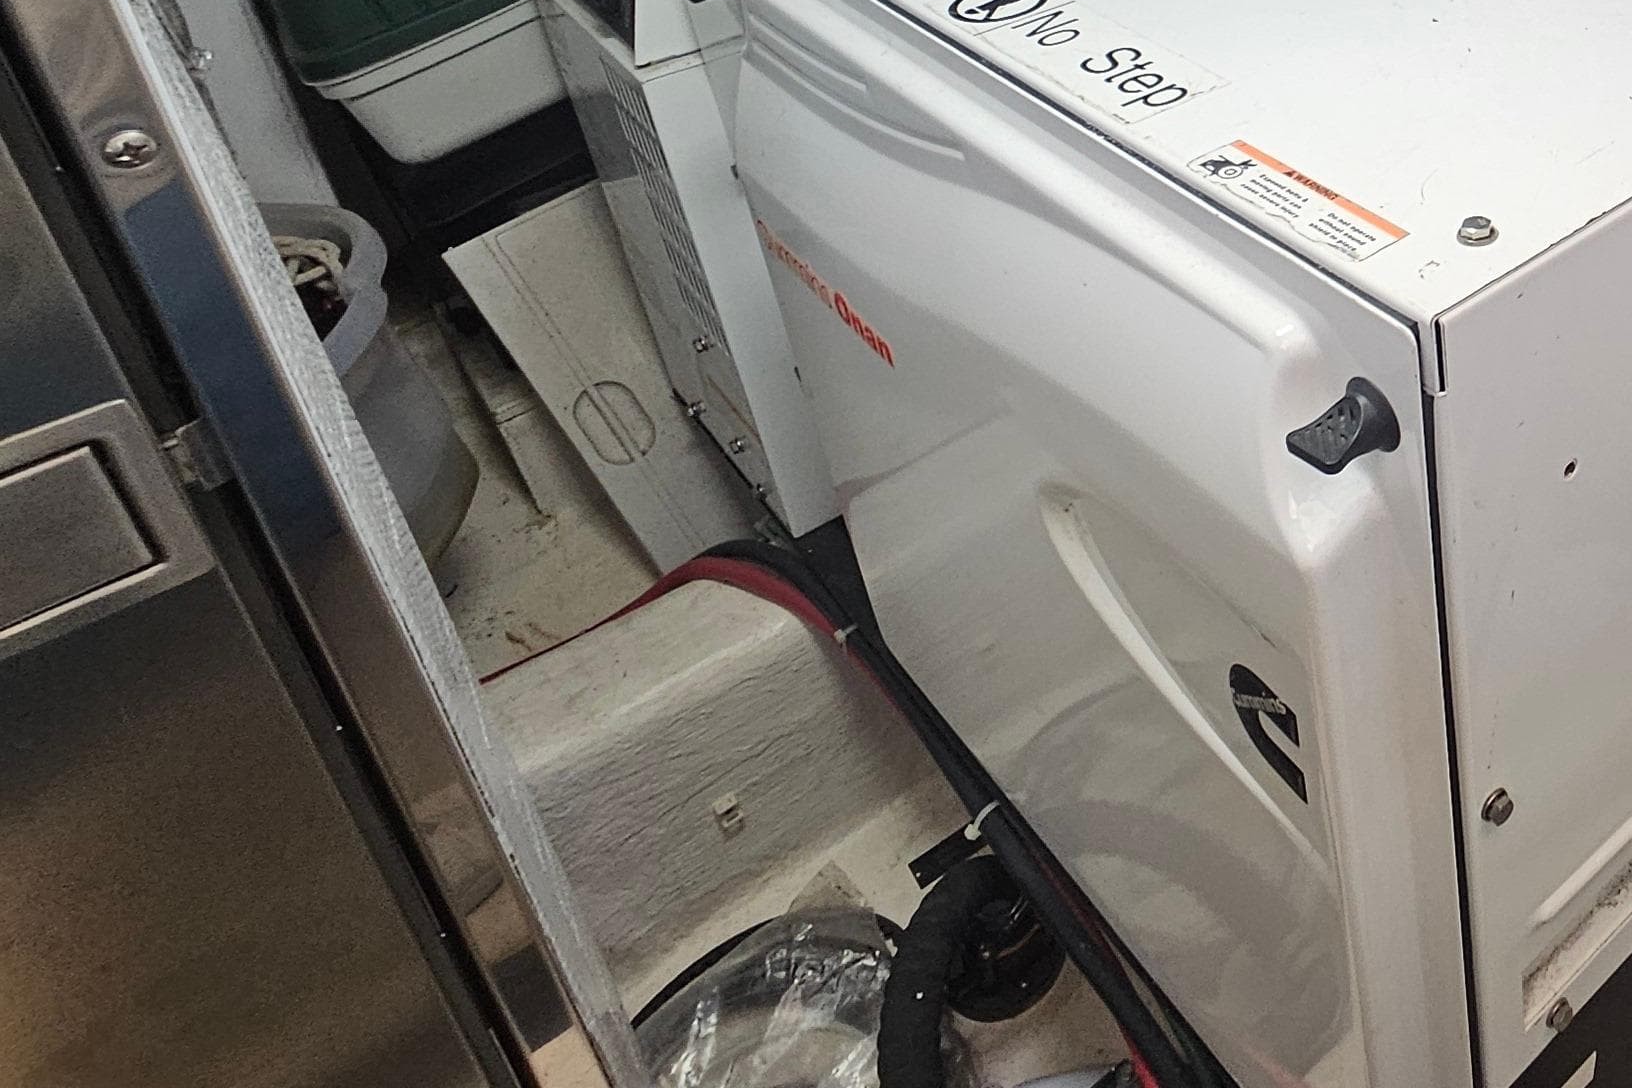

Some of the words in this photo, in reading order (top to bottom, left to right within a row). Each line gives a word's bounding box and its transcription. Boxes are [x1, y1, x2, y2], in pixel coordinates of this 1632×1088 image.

[1011, 9, 1081, 49] No
[1080, 46, 1189, 109] Step
[1293, 171, 1339, 201] WARNING
[833, 291, 896, 369] Onan
